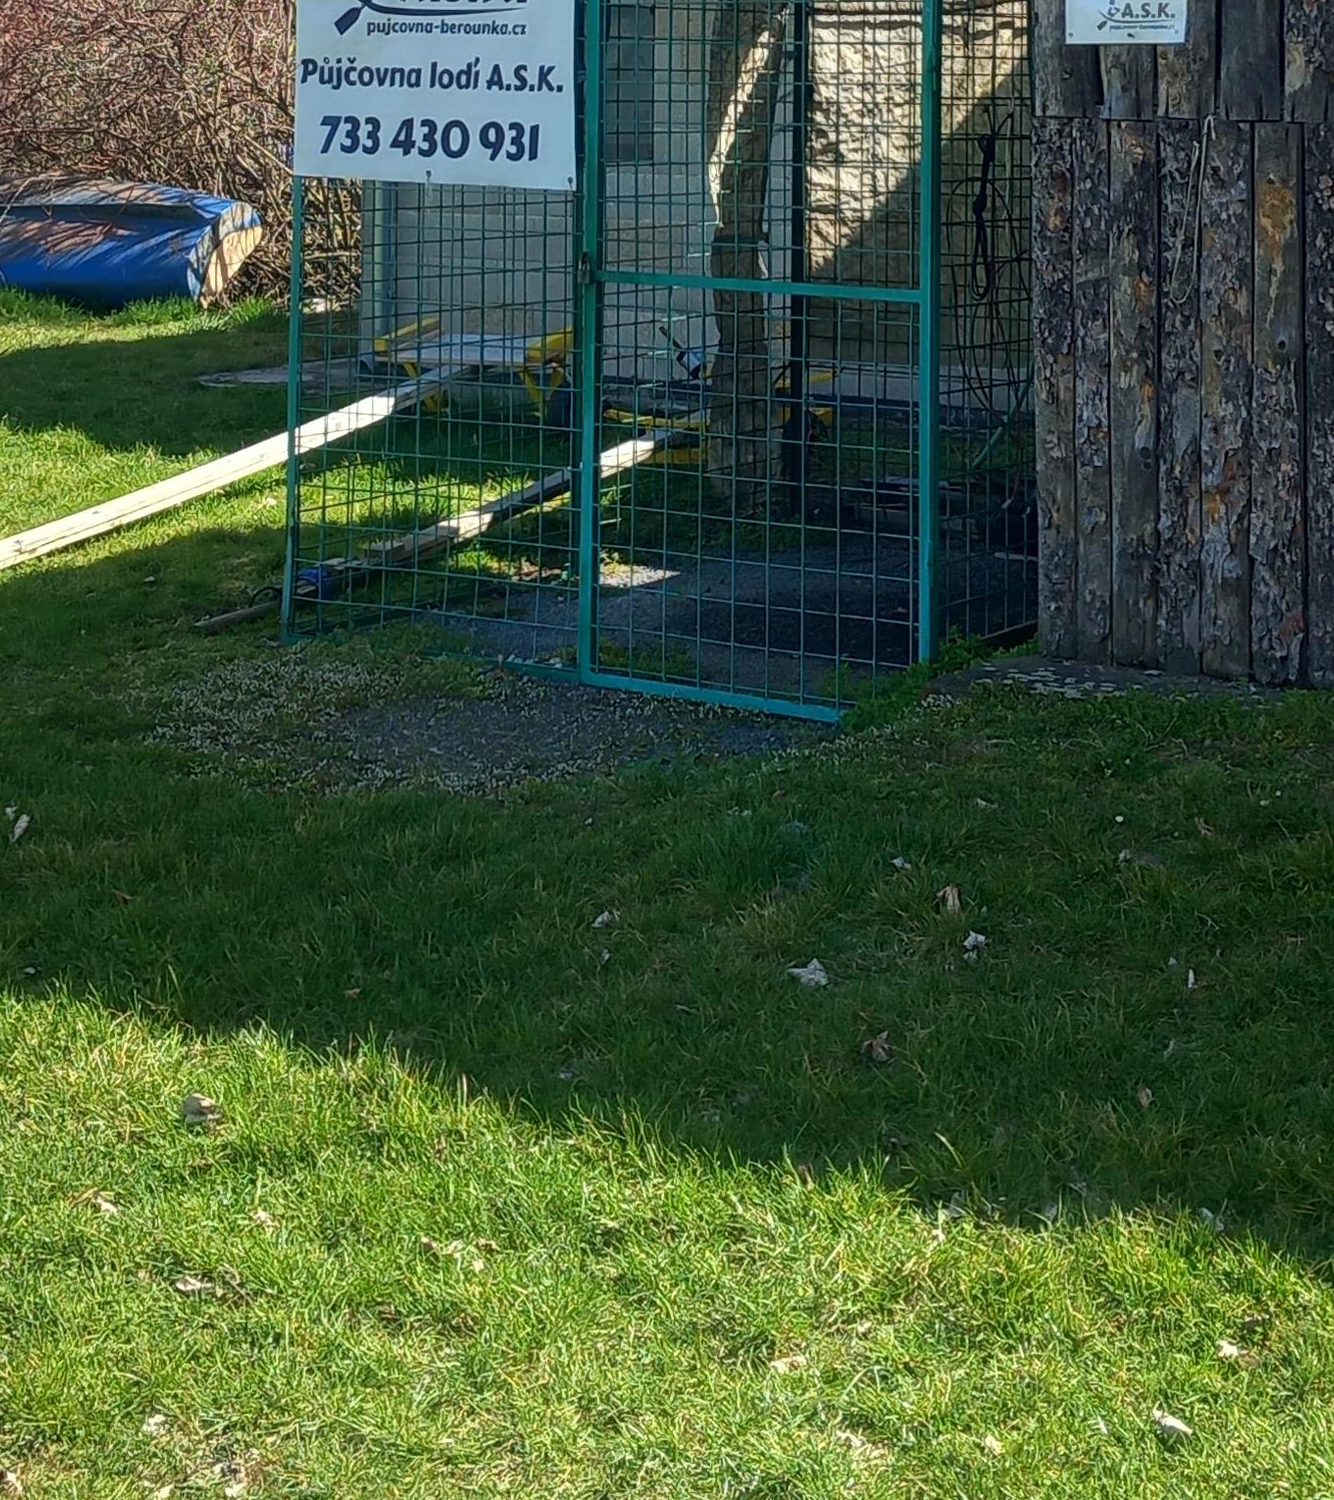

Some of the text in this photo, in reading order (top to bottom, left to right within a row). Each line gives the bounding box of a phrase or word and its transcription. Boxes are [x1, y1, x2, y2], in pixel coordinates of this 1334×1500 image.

[1121, 2, 1176, 19] A.S.K.
[366, 18, 527, 36] pujcovna-berounka.cz
[300, 56, 564, 93] Půjčovna lodí A.S.K.
[319, 115, 540, 162] 733 430 931
